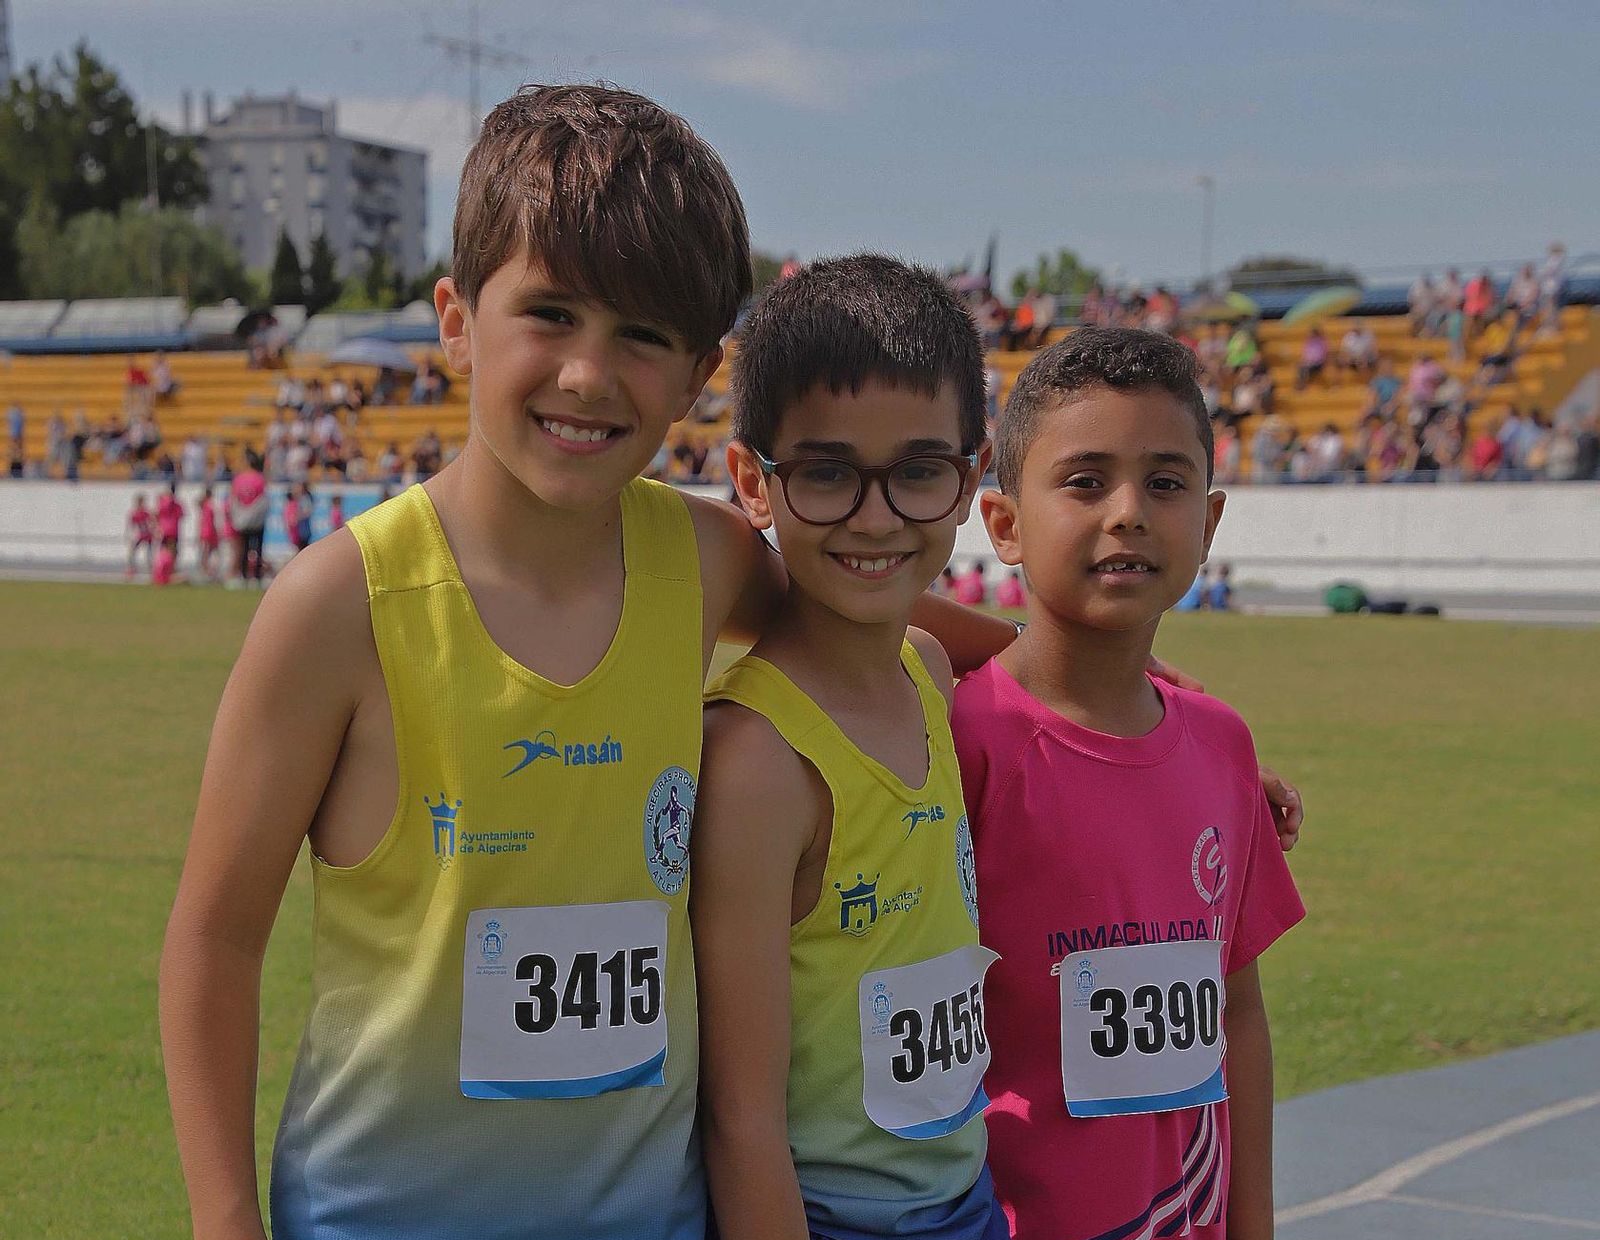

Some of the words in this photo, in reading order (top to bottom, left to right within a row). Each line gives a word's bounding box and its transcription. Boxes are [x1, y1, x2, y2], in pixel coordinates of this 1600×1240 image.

[646, 772, 673, 825] ALGECIRAS
[460, 831, 535, 843] Ayuntamiento
[460, 844, 474, 853] de
[477, 843, 528, 855] Algeciras
[652, 870, 686, 893] ATLETIS
[1047, 918, 1209, 957] INMACULADA
[513, 947, 661, 1035] 3415
[889, 981, 987, 1085] 3455
[1089, 977, 1219, 1059] 3390
